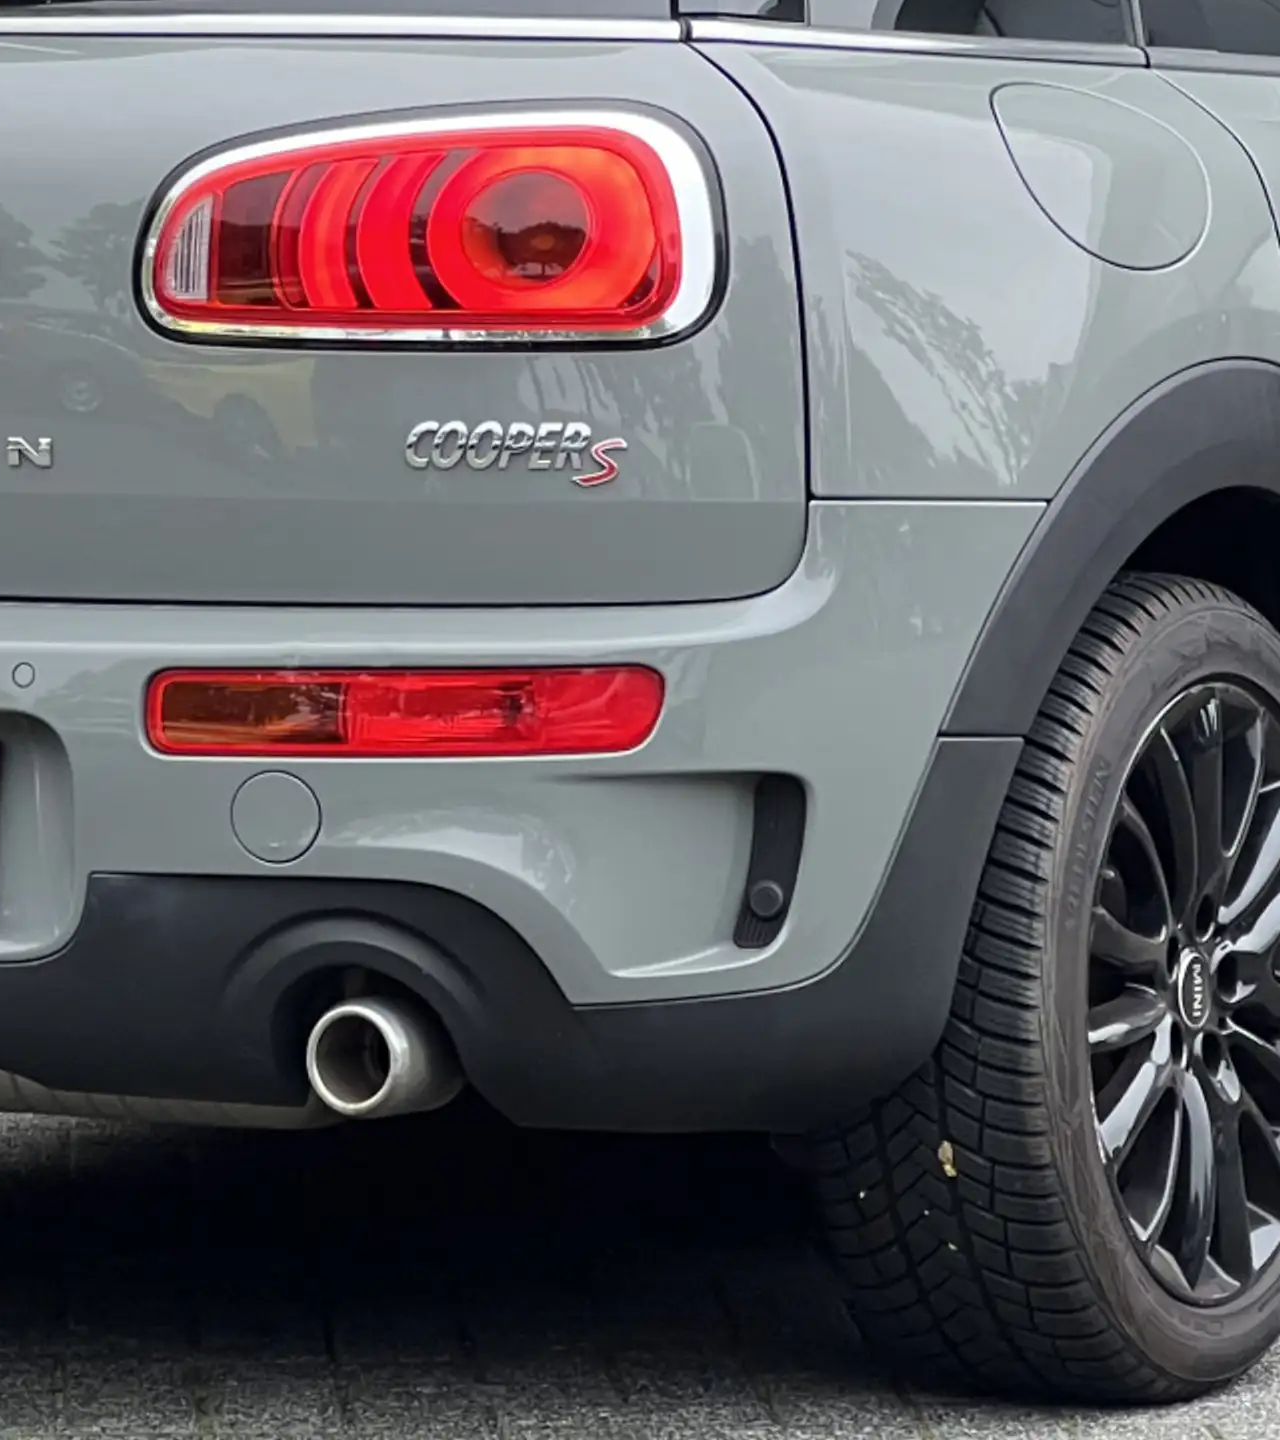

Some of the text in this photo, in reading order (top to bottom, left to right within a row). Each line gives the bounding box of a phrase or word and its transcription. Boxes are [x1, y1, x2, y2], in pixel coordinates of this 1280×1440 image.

[405, 420, 628, 487] COOPER S
[1191, 962, 1204, 1018] MINI
